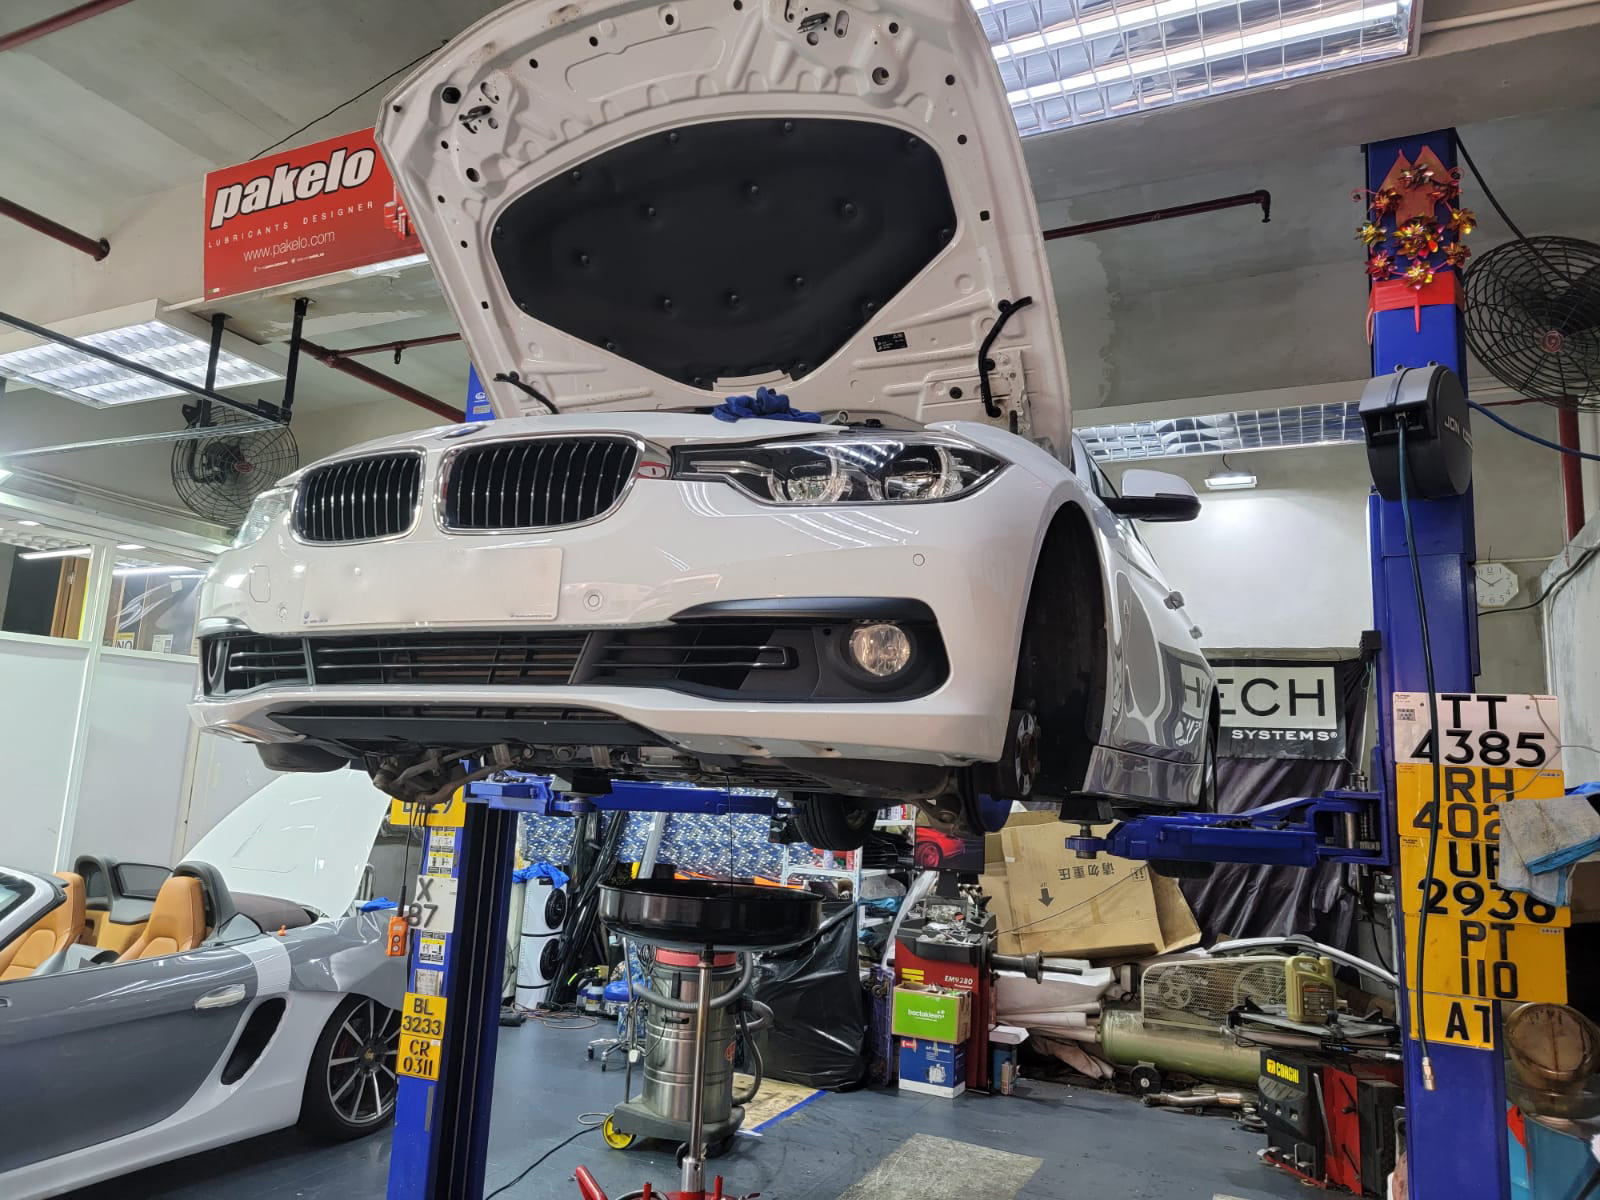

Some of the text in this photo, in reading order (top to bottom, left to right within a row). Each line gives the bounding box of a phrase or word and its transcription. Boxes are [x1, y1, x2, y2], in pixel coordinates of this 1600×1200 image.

[210, 148, 376, 228] pakelo
[208, 201, 373, 248] LUBRICANTS DESIGNER
[243, 230, 336, 261] www.pakelo.com
[1441, 694, 1507, 730] TT
[1410, 729, 1546, 768] 4385
[1444, 766, 1515, 803] RH
[1412, 801, 1499, 840] 402
[416, 878, 434, 902] X
[1417, 878, 1556, 924] 2936
[407, 903, 438, 928] 87
[1459, 920, 1515, 960] PT
[413, 997, 434, 1016] BL
[402, 1015, 442, 1035] 3233
[409, 1039, 430, 1057] CR
[1275, 1062, 1299, 1084] CORGHI
